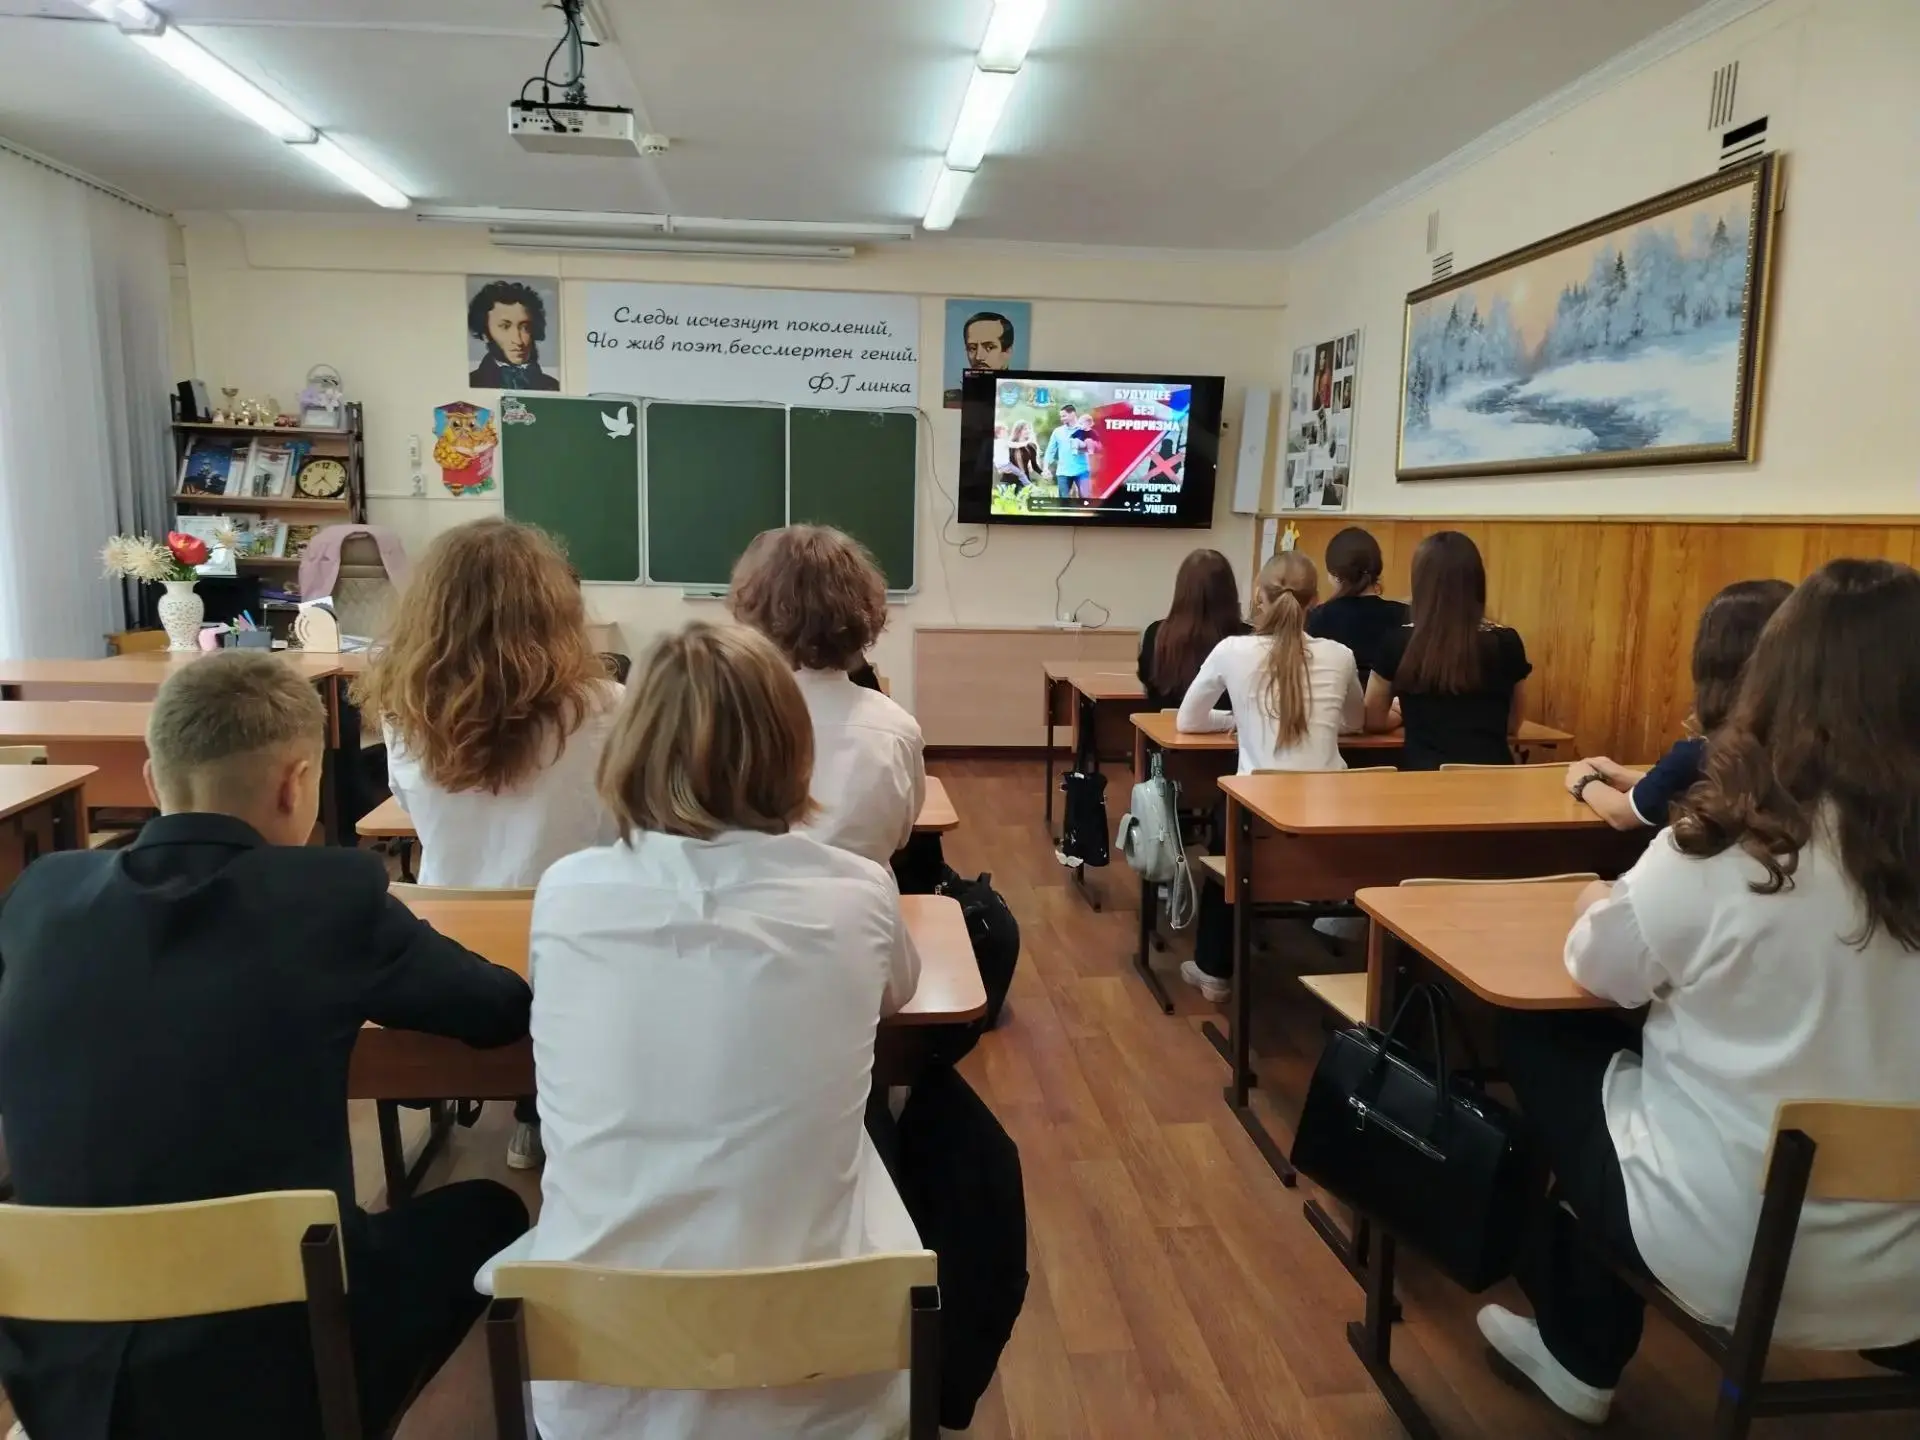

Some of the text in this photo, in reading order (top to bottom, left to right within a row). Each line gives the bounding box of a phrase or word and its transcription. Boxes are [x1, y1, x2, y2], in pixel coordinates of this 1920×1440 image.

[613, 306, 893, 338] Следы исчезнут поколений,
[586, 331, 619, 349] Но
[625, 334, 665, 350] жив
[860, 347, 918, 362] гений.
[1114, 388, 1171, 401] БУДУЩЕЕ
[1132, 404, 1155, 416] БЕЗ
[1104, 418, 1180, 431] ТЕРРОРИЗМА
[1125, 482, 1181, 494] ТЕРРОРИЗМ
[1142, 493, 1162, 503] БЕЗ
[1143, 504, 1177, 515] УЩЕГО
